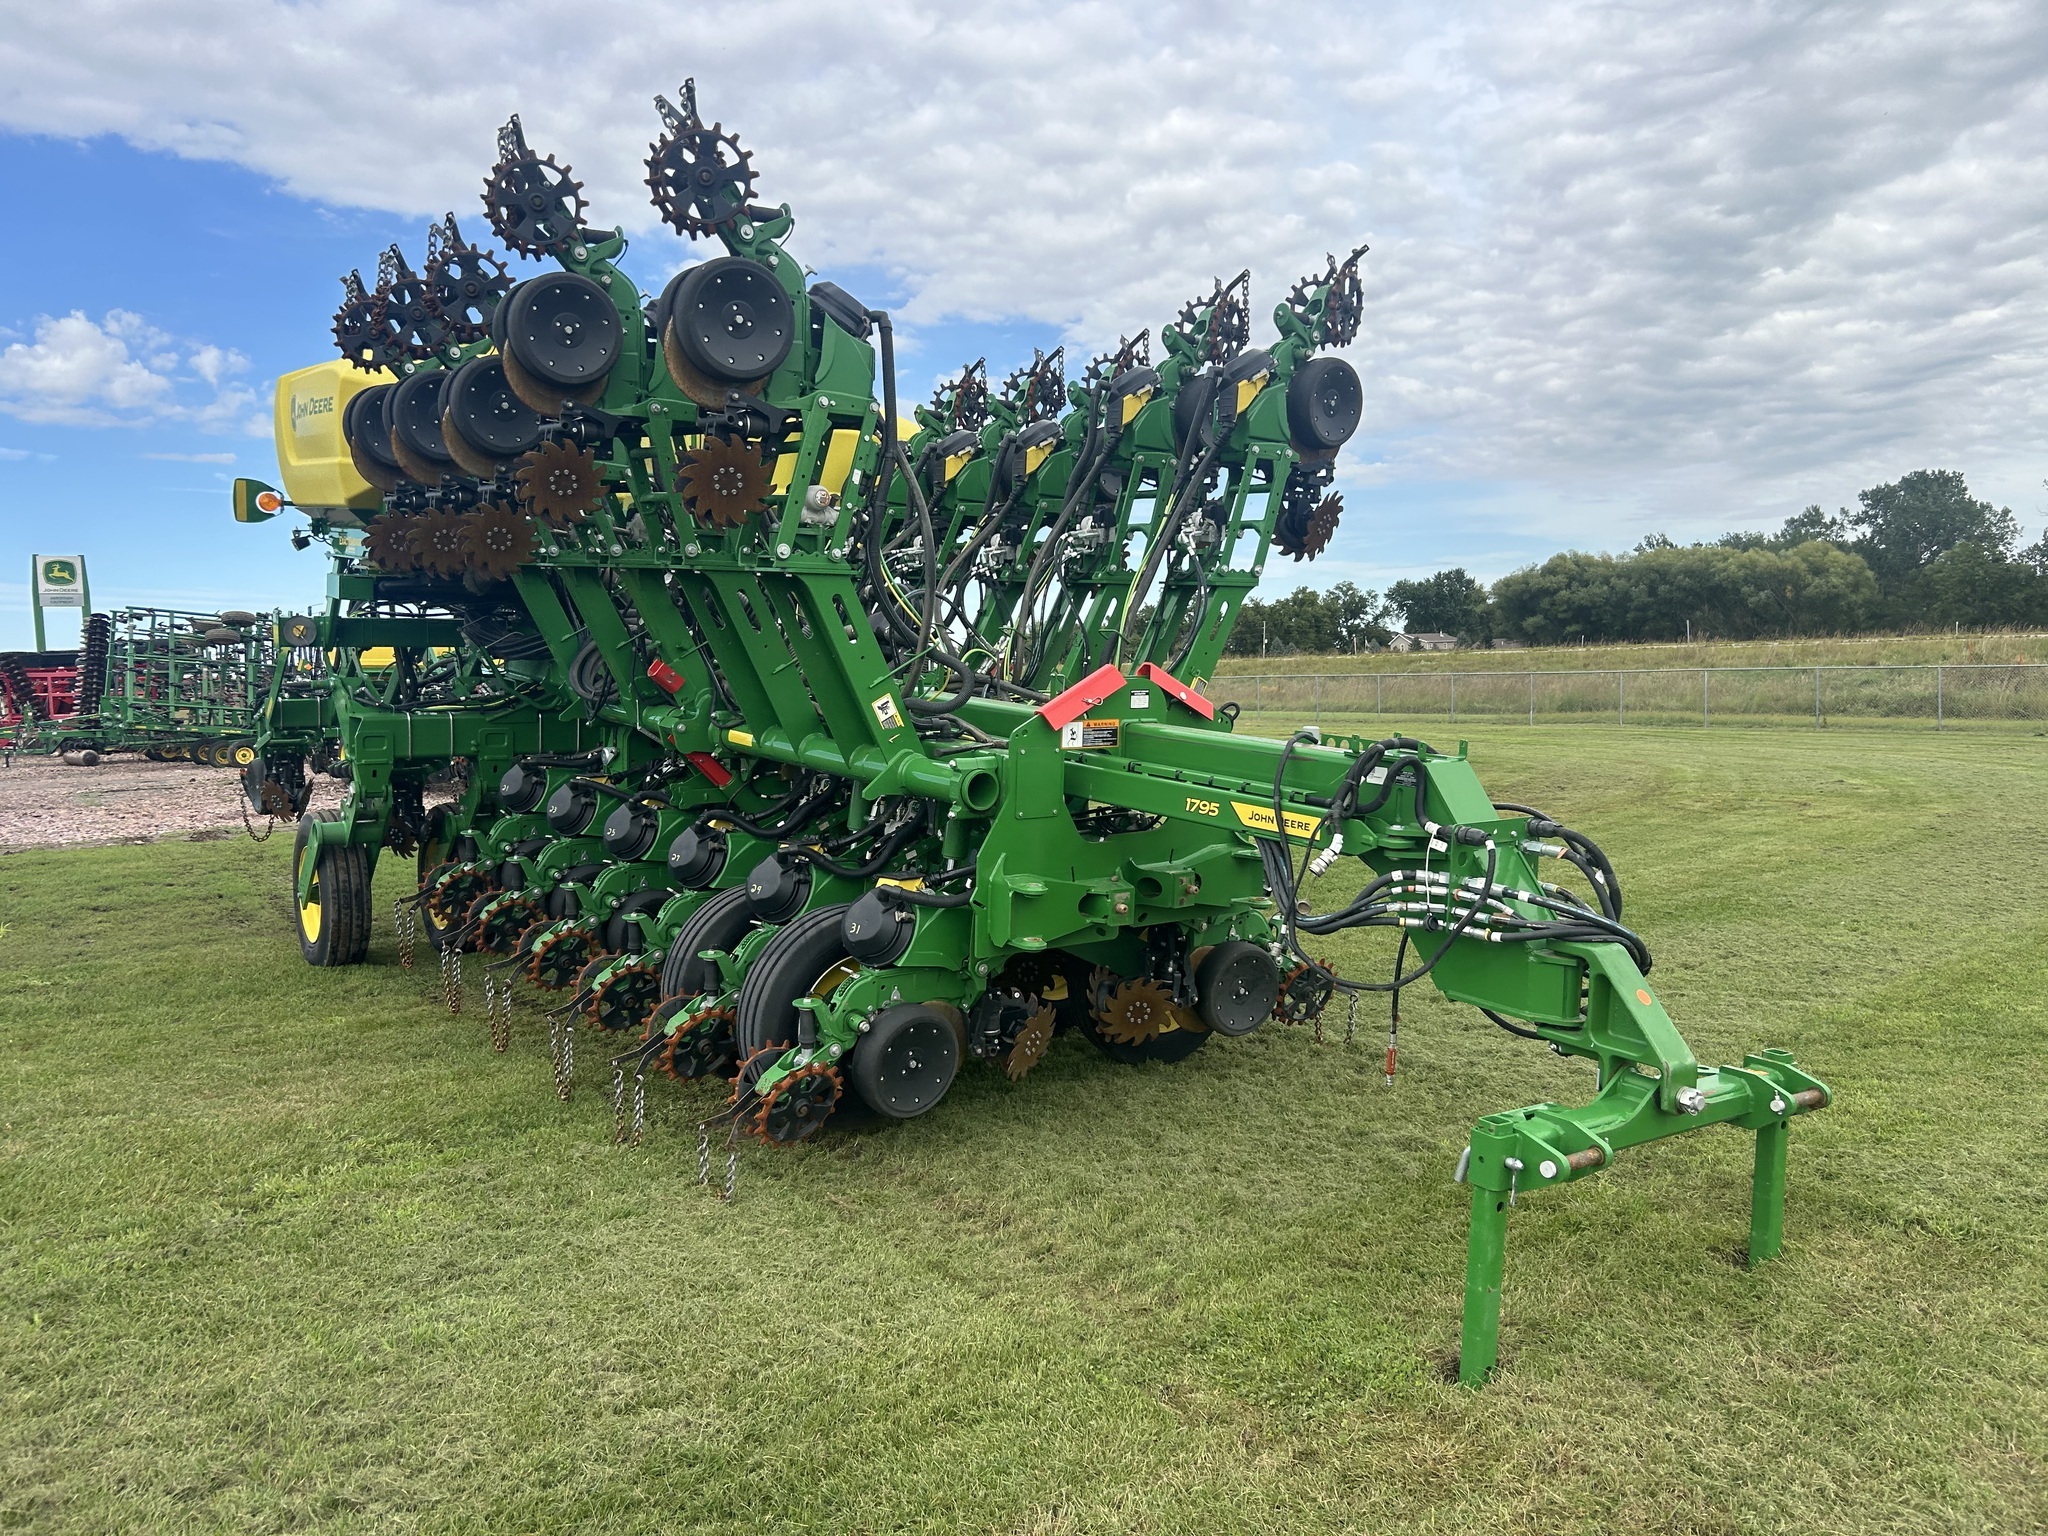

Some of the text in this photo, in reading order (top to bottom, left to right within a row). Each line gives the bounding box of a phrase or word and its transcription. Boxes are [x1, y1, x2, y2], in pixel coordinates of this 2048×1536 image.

[309, 396, 334, 416] DEERE
[1185, 797, 1220, 817] 1795
[1248, 810, 1311, 832] JOHN EERE
[849, 922, 861, 935] 31
